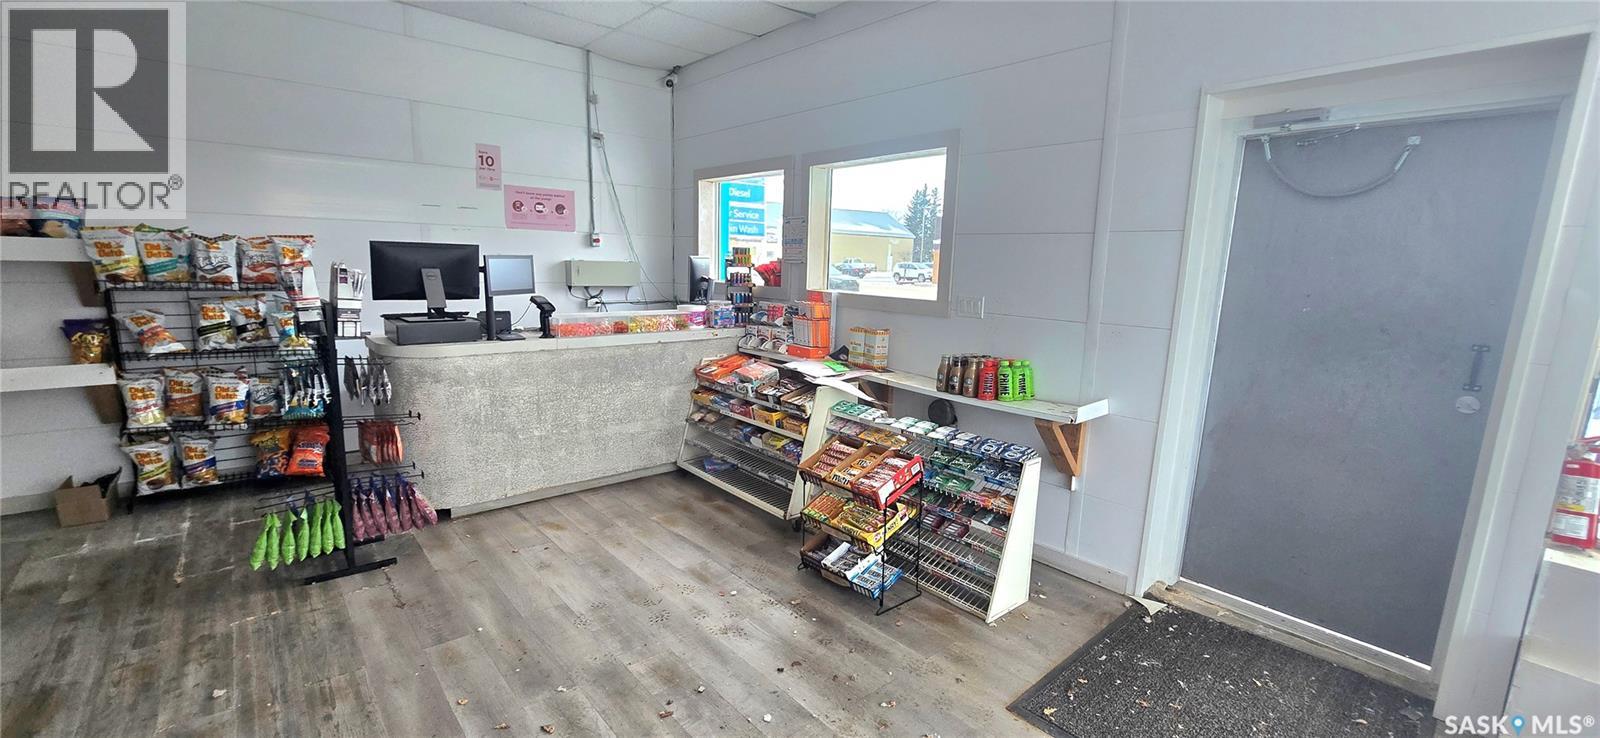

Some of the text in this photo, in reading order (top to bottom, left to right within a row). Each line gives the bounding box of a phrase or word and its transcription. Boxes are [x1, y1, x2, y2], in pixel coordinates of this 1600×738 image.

[478, 154, 495, 168] 10
[728, 187, 752, 198] Diesel
[734, 208, 760, 219] Service
[739, 223, 760, 234] Wash
[983, 372, 994, 394] PRIME
[999, 373, 1010, 396] PRIME
